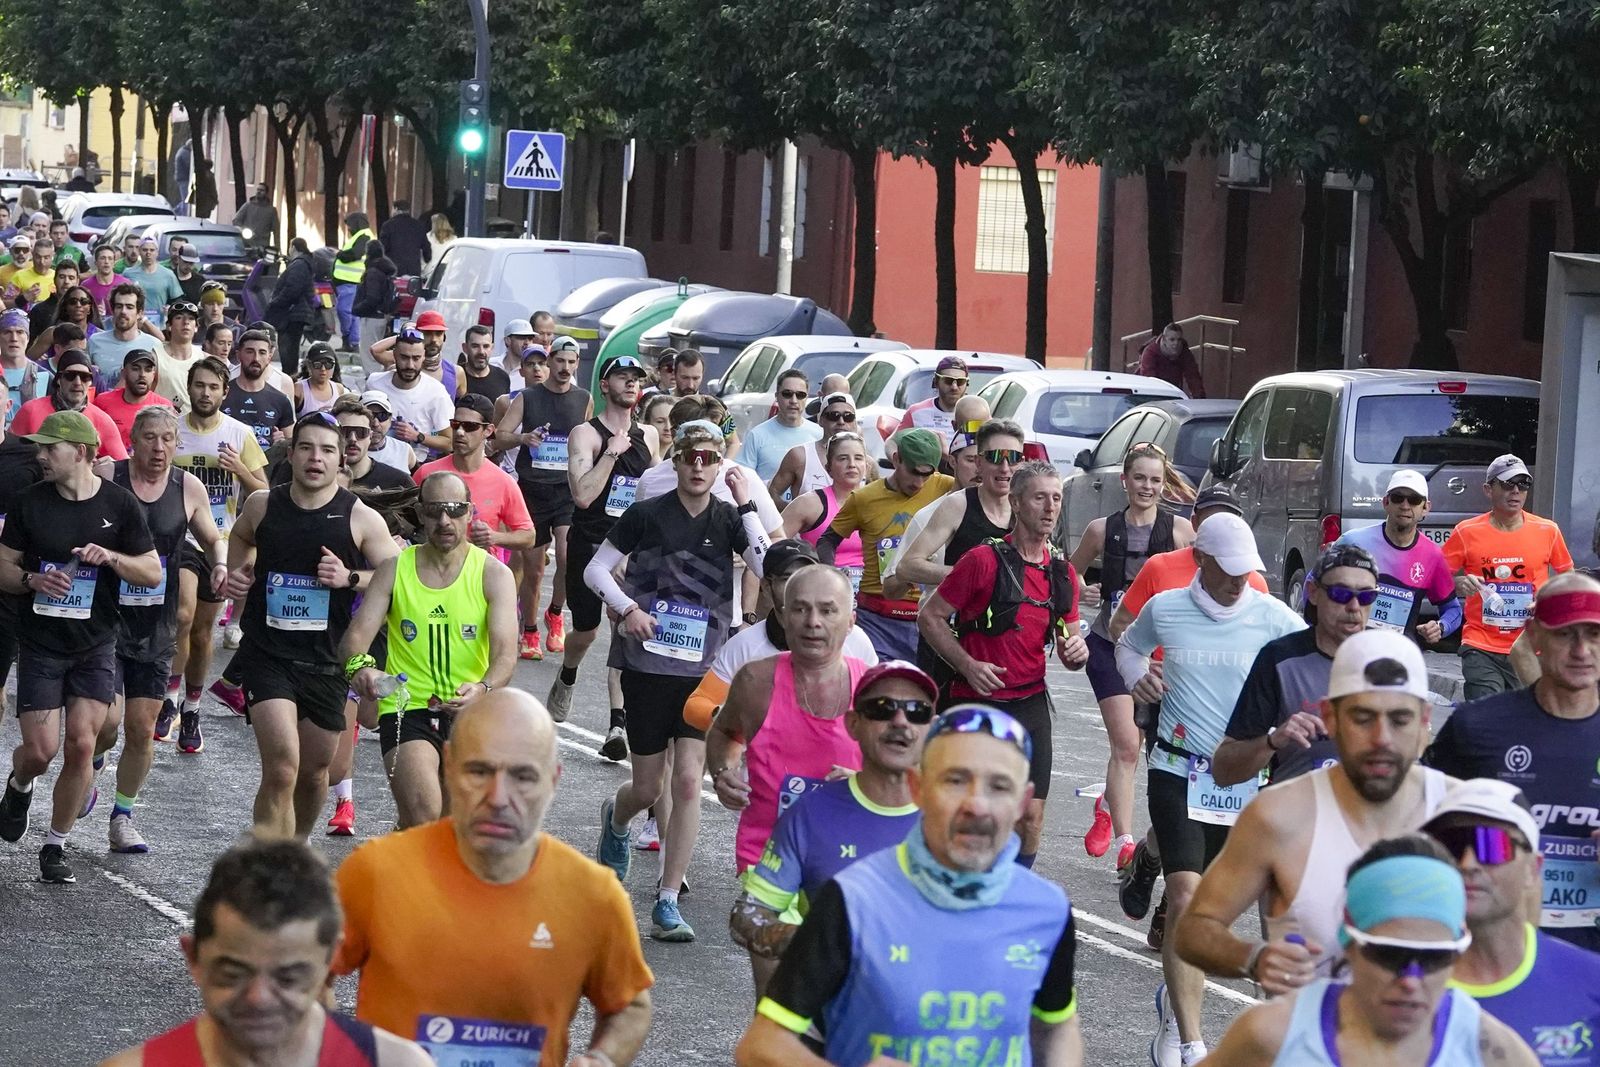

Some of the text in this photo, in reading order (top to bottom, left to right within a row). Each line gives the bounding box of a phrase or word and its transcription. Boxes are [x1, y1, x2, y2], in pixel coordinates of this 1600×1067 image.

[252, 425, 271, 436] RID
[192, 455, 206, 466] 59
[607, 499, 630, 509] JESUS
[287, 577, 323, 588] ZURICH
[126, 583, 150, 595] NEIL
[1379, 587, 1408, 599] ZURICH
[1500, 585, 1528, 593] ZURICH
[287, 594, 306, 603] 9440
[281, 604, 310, 617] NICK
[671, 605, 704, 618] ZURICH
[1374, 609, 1388, 621] R3
[655, 629, 702, 649] UGUSTIN
[1168, 648, 1252, 667] ALENCIA
[1201, 793, 1243, 810] CALOU
[1544, 870, 1575, 882] 9510
[918, 990, 1006, 1030] CDC
[461, 1025, 530, 1043] ZURICH
